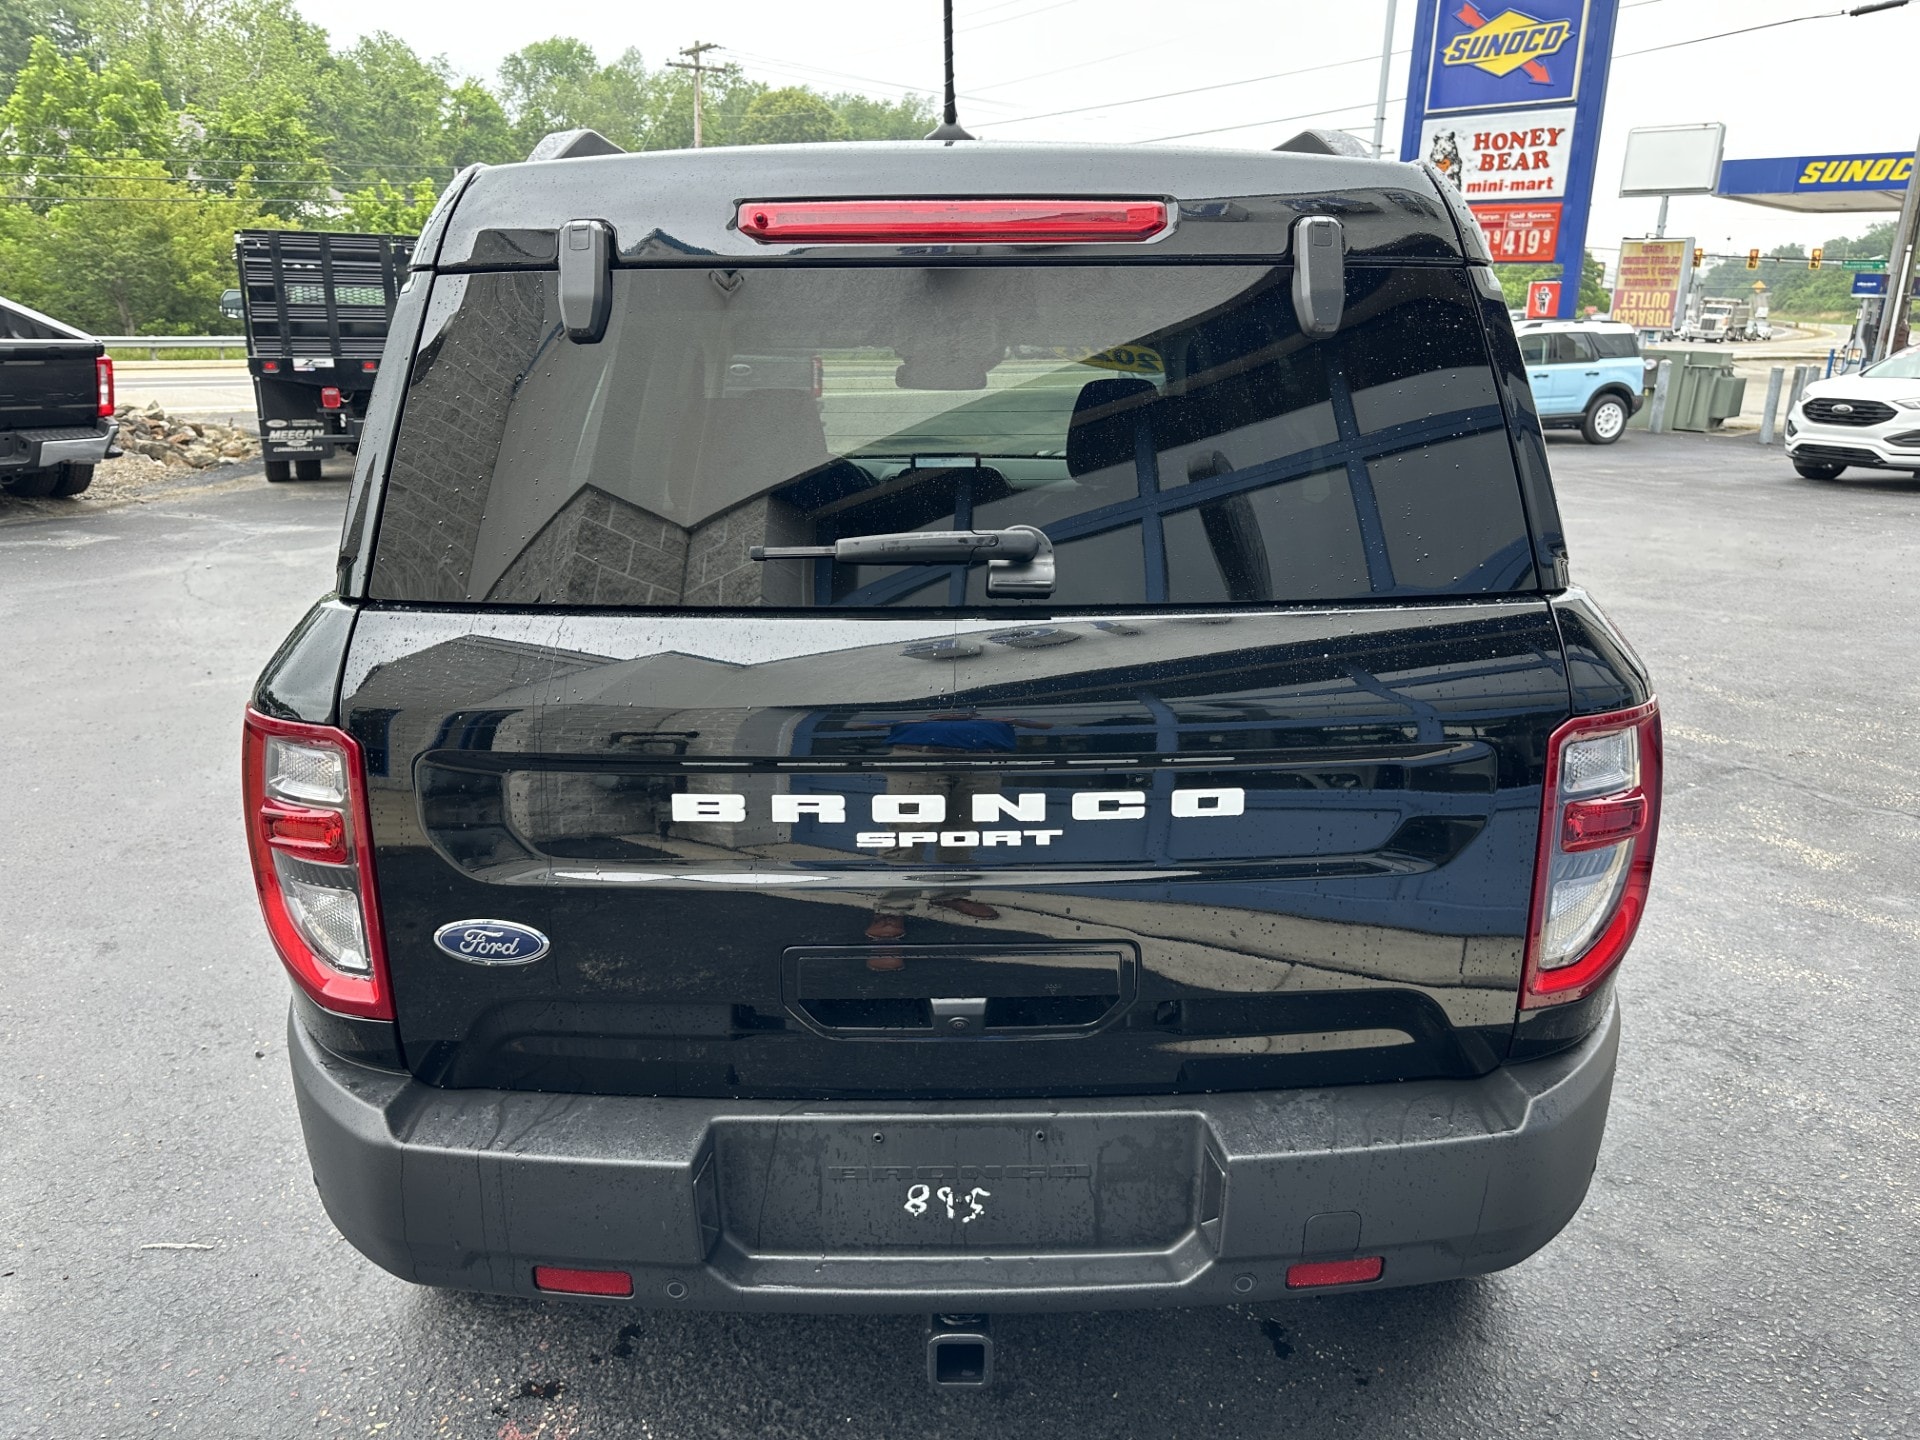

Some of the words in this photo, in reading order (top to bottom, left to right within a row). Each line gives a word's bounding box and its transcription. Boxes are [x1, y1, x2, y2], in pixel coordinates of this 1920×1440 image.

[1448, 24, 1568, 62] SUNOCO
[1472, 128, 1566, 152] HONEY
[1478, 150, 1551, 172] BEAR
[1798, 157, 1914, 184] SUNOC
[1466, 177, 1554, 193] mini-mart
[1620, 291, 1671, 309] OUTLET
[1612, 309, 1671, 327] TOBACCO
[268, 429, 325, 440] MEEGAN
[671, 787, 1245, 824] BRONCO
[856, 829, 1063, 848] SPORT
[459, 928, 520, 956] Ford
[903, 1184, 992, 1223] 895
